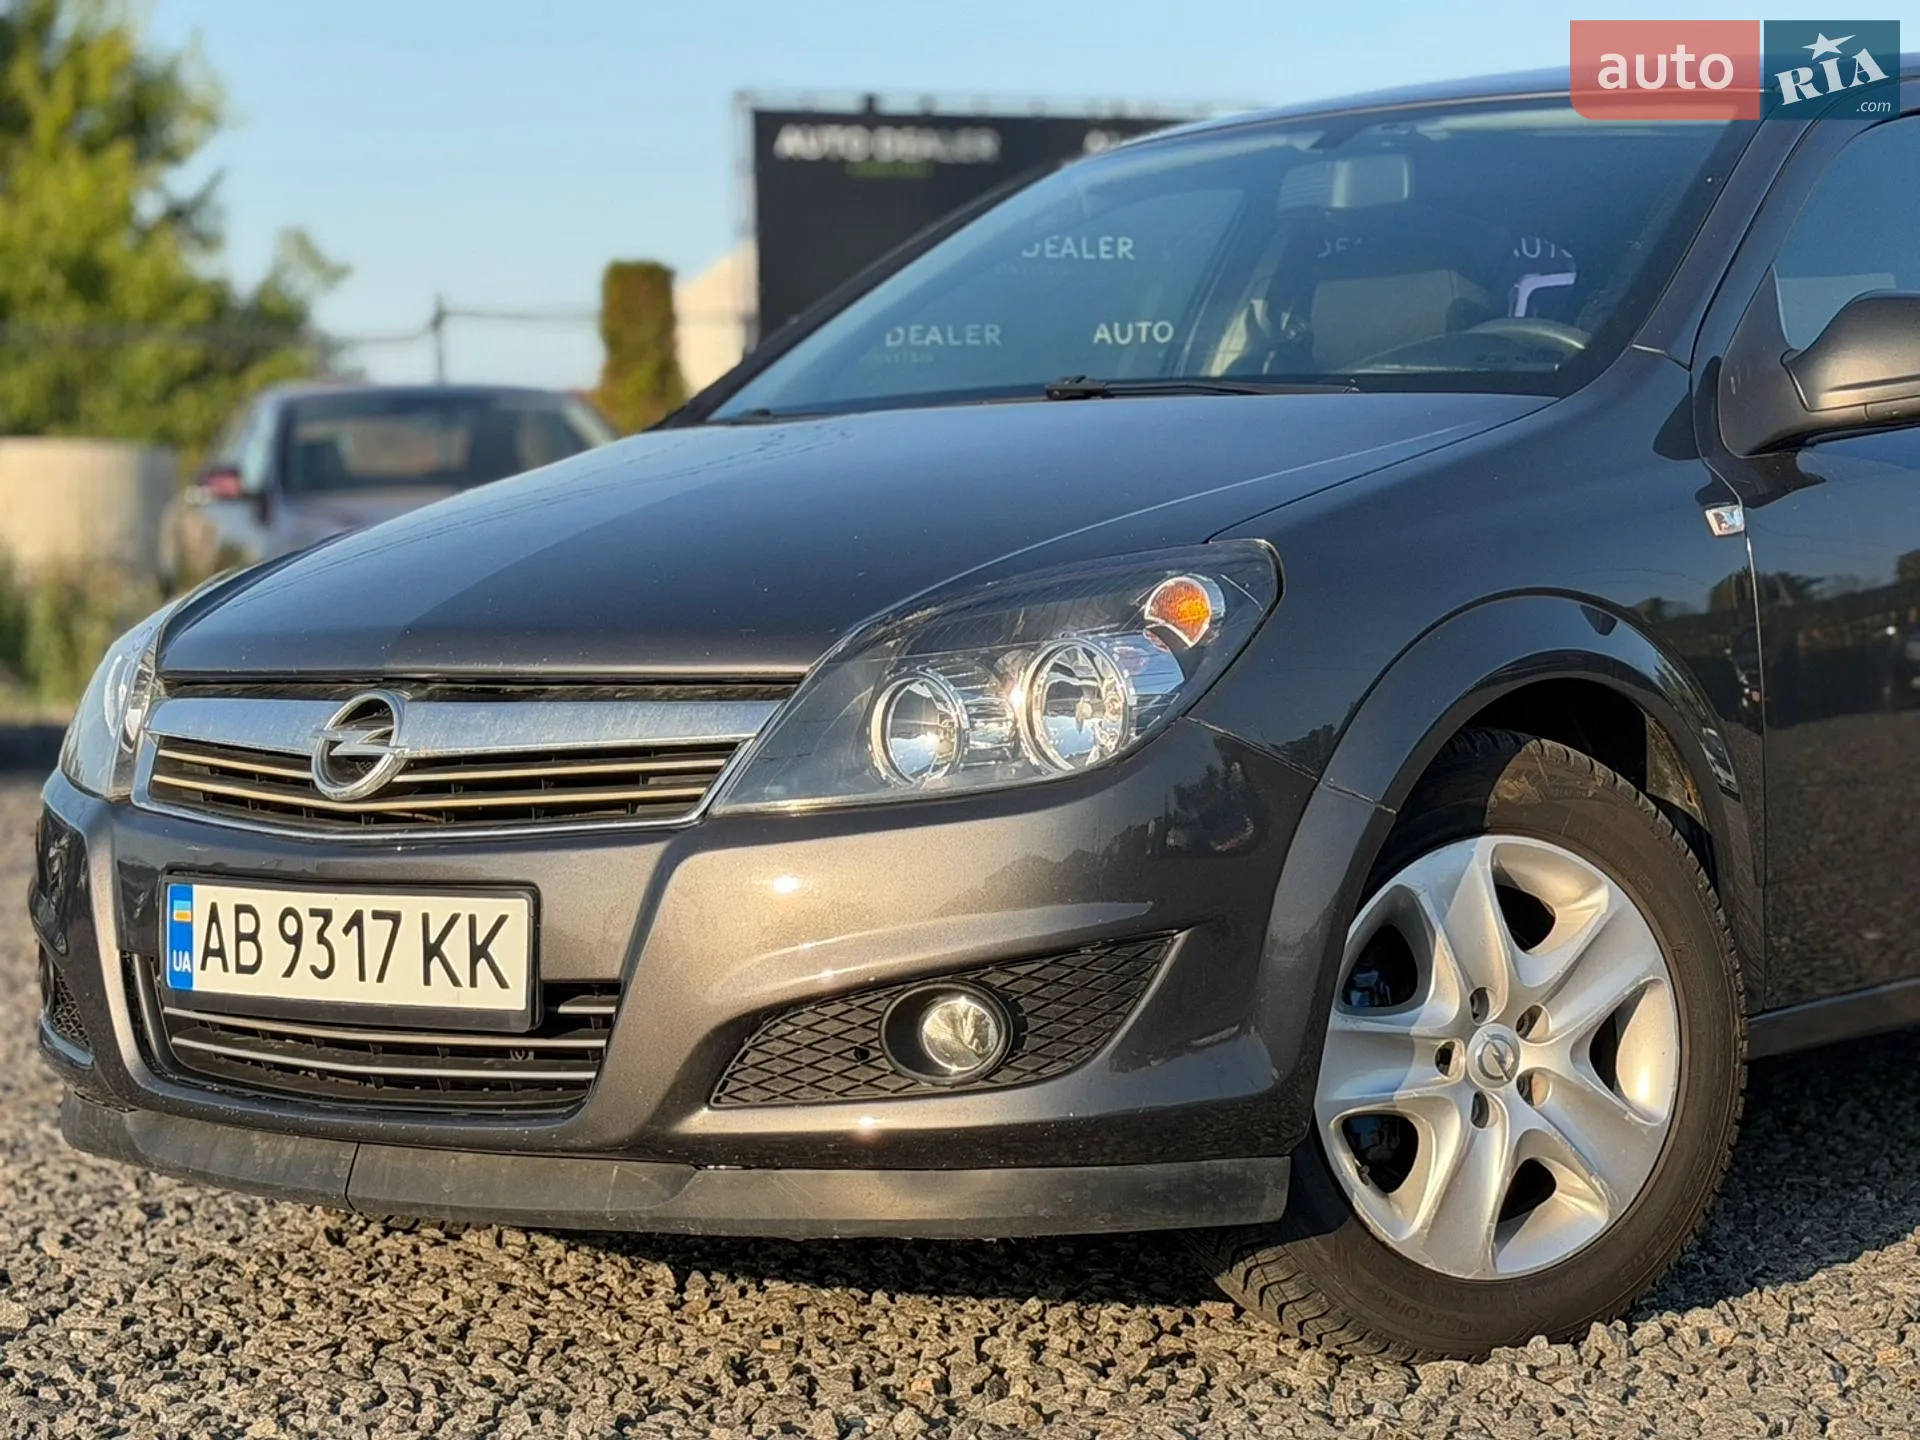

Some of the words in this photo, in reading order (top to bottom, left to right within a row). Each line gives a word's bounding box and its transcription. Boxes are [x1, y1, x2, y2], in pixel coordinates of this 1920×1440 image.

[885, 323, 1002, 348] DEALER
[1092, 320, 1175, 345] AUTO
[199, 901, 263, 976] AB
[278, 906, 402, 984] 9317
[422, 911, 511, 990] KK
[173, 949, 192, 974] UA
